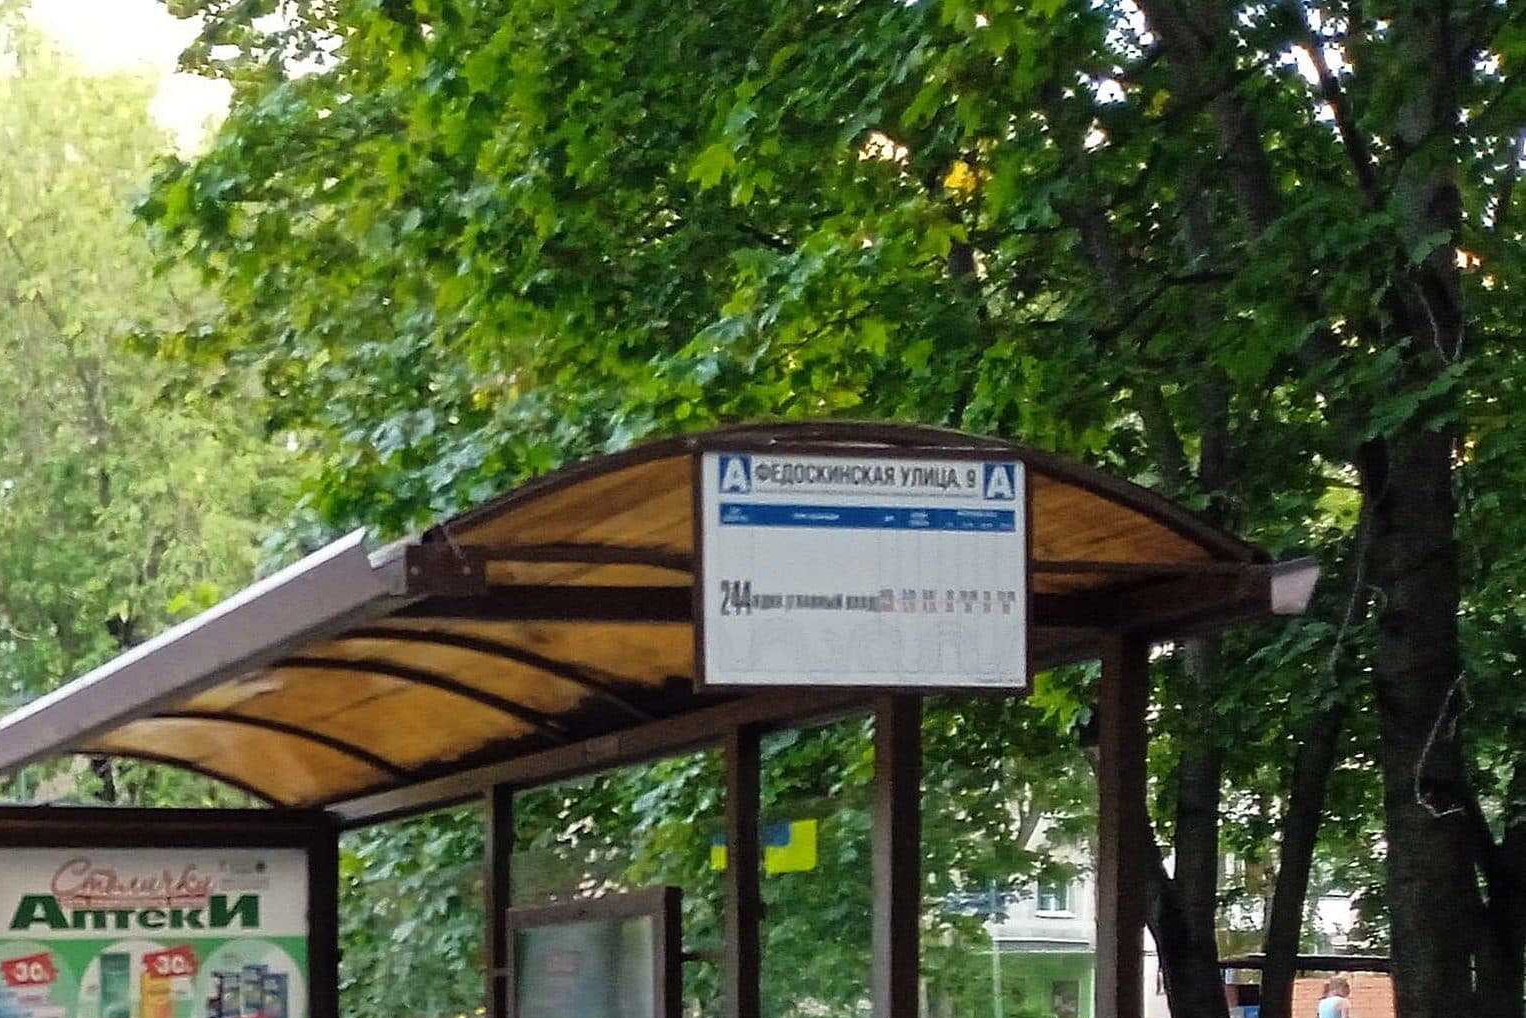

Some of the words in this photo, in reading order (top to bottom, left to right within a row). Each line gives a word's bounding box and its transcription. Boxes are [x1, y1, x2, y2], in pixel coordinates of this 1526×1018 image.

[755, 462, 895, 486] ФЕДОСКИНСКАЯ
[966, 468, 976, 488] 9
[721, 580, 752, 616] 244
